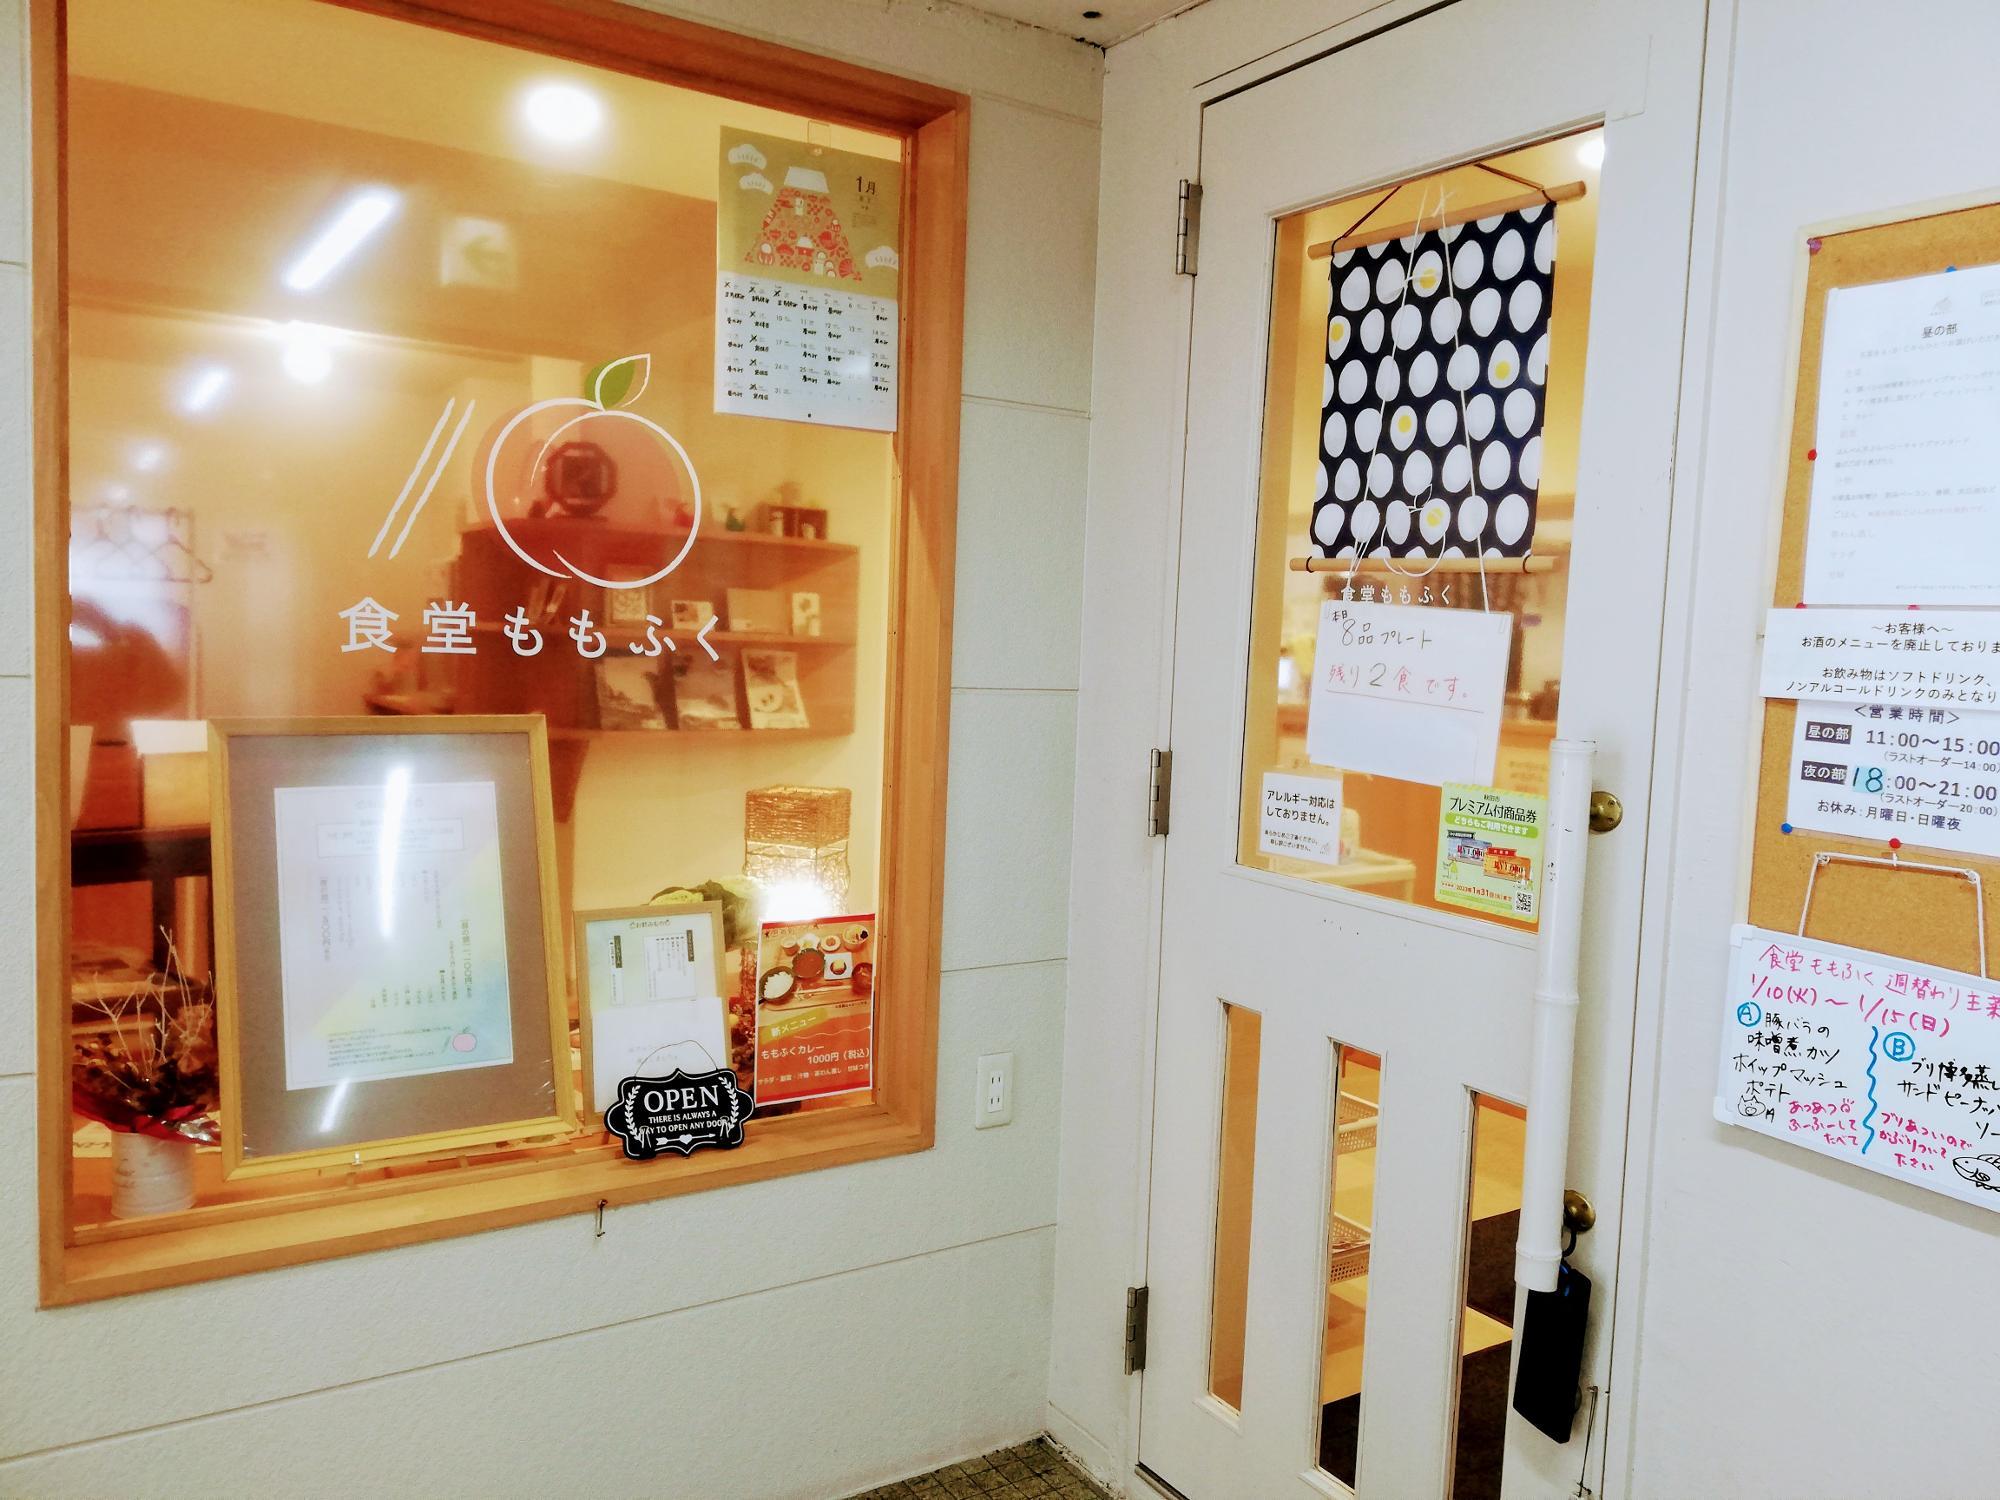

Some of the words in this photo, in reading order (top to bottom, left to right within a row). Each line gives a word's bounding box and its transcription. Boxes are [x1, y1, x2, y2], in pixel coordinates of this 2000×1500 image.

[855, 175, 876, 195] 1月
[1341, 585, 1450, 604] 食堂ももふく
[338, 597, 720, 661] 食堂ももふく
[1786, 681, 1998, 703] ノンアルコールドリンクのみとなり
[1807, 724, 1850, 742] 昼の部
[1803, 764, 1847, 782] 夜の部
[1267, 790, 1335, 809] アレルギー対応は
[1266, 805, 1329, 826] しておりません。
[1449, 796, 1537, 824] プレミアム付商品券
[770, 1016, 818, 1037] 新メニュー
[1765, 1012, 1830, 1038] 豚バラの
[761, 1043, 826, 1059] ももふくカレー
[643, 1085, 719, 1113] OPEN
[1746, 1080, 1791, 1102] ポテト
[649, 1114, 672, 1124] THERE
[682, 1112, 710, 1120] ALWAYS
[656, 1126, 667, 1134] TO
[668, 1123, 689, 1132] OPEN
[1823, 1132, 1859, 1147] たべて
[1894, 1152, 1935, 1172] 下さい
